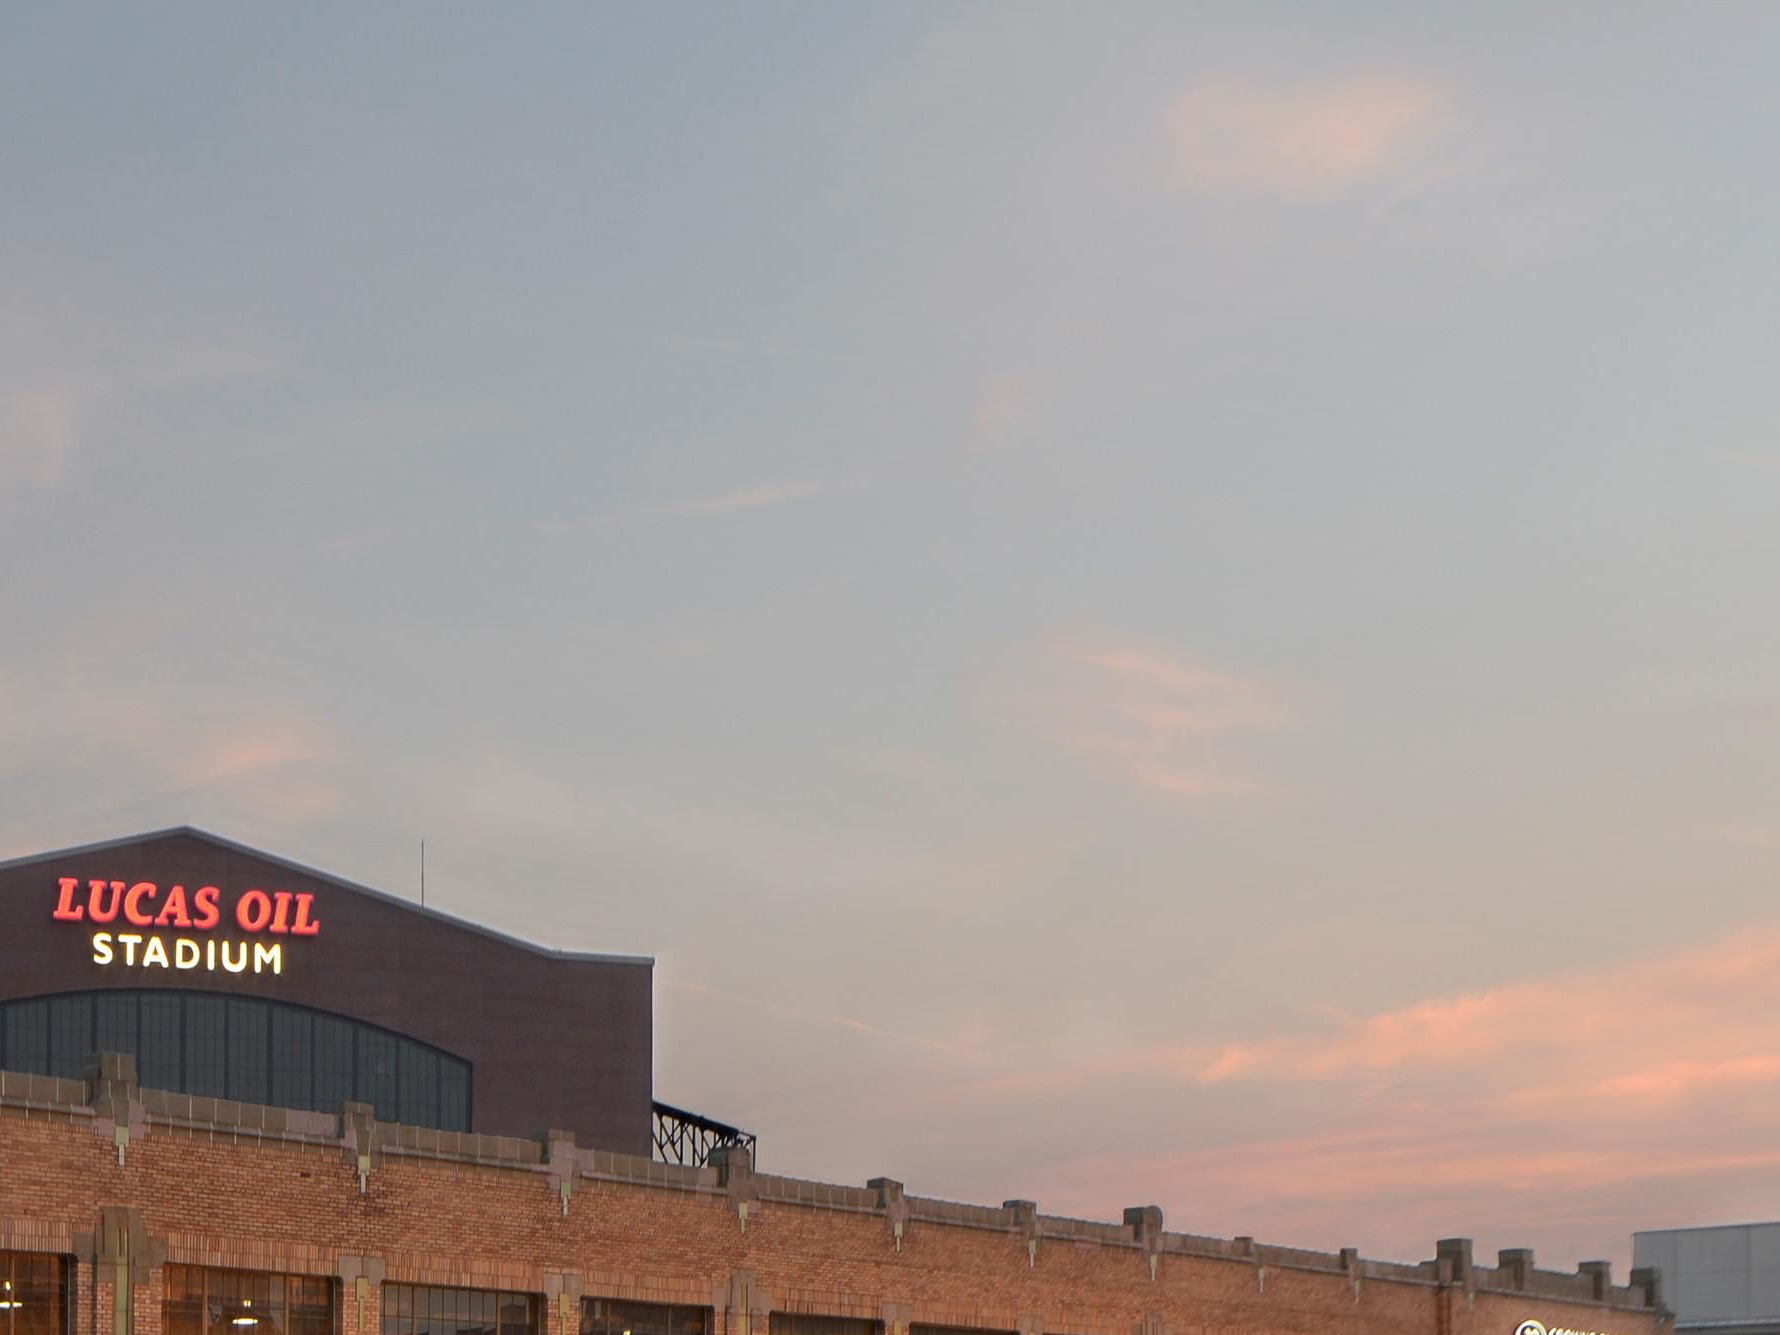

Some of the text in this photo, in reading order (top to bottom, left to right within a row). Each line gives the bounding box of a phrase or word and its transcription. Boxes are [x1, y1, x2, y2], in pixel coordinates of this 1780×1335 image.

[53, 877, 320, 936] LUCAS OIL
[92, 932, 282, 975] STADIUM
